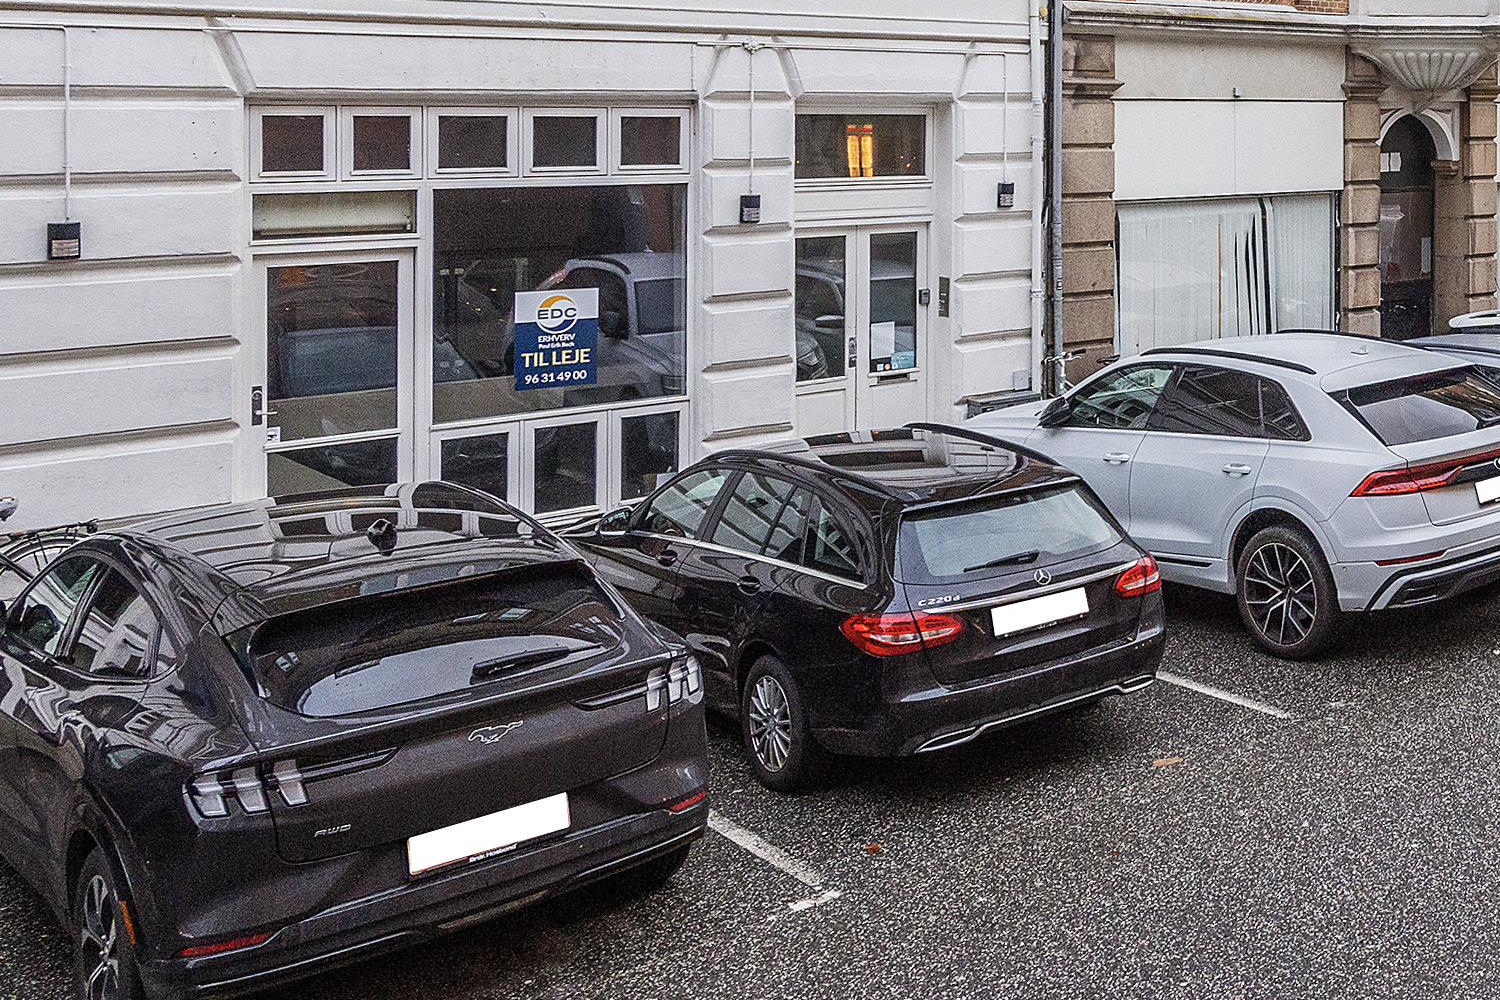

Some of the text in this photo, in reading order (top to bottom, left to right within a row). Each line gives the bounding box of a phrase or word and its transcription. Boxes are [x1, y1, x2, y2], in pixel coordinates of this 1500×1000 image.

[537, 307, 577, 320] EDC
[537, 333, 576, 342] ERHVERV
[521, 348, 591, 368] TIL LEJE
[524, 369, 588, 385] 96 31 49 00
[314, 824, 351, 838] AWD
